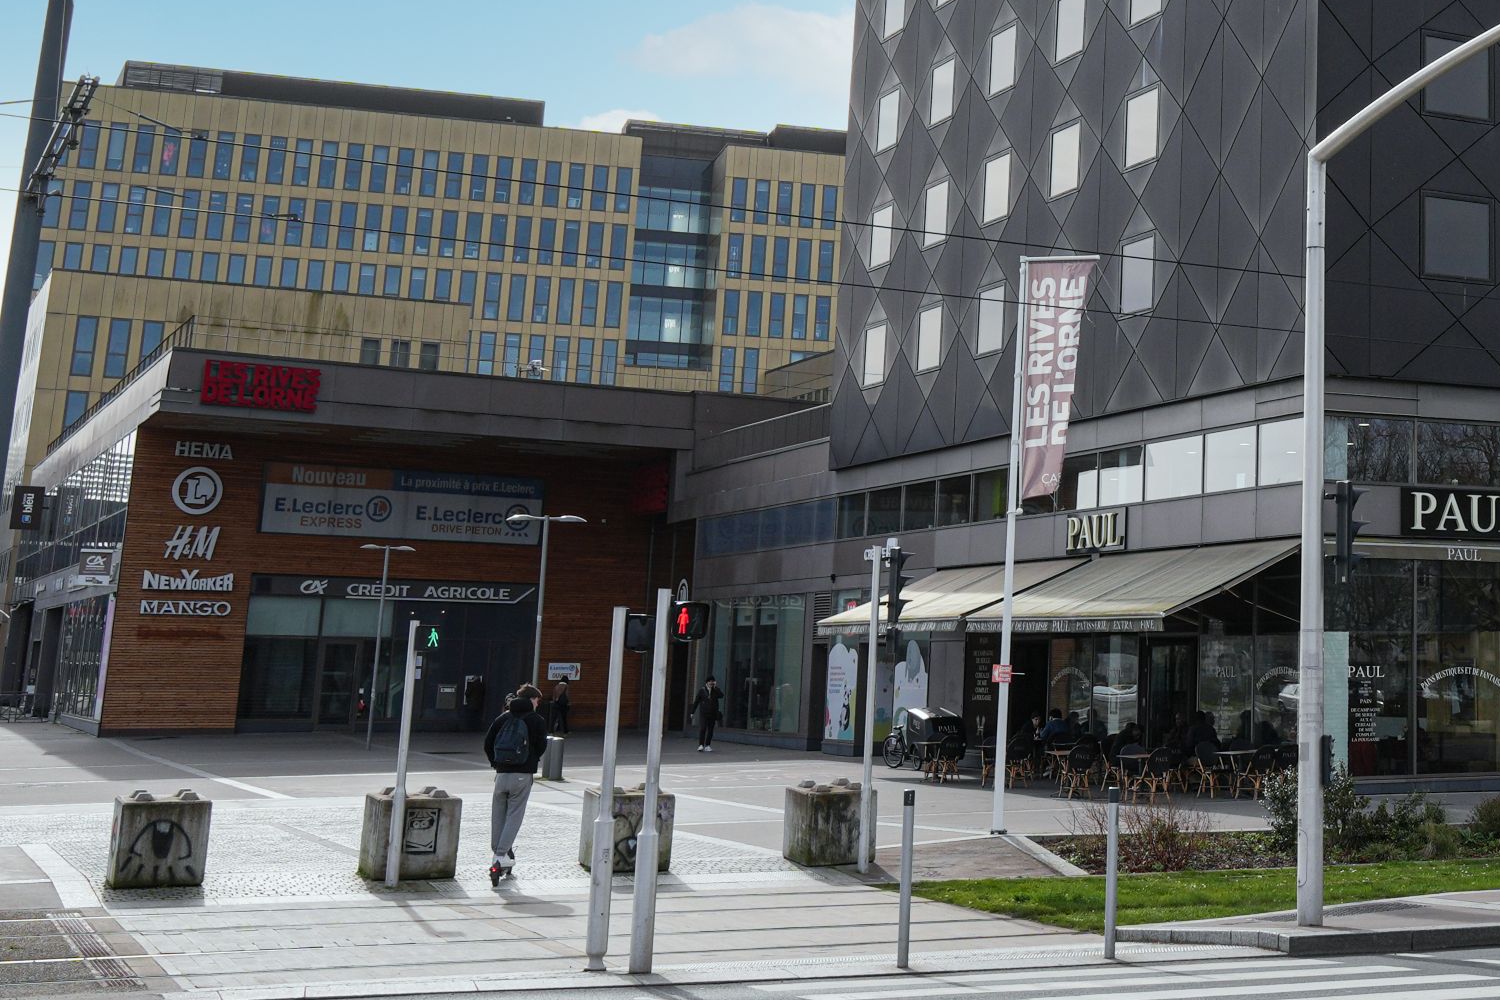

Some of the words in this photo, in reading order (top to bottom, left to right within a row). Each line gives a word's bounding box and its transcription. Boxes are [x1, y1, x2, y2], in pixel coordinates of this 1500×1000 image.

[1028, 277, 1057, 376] RIVES
[204, 359, 249, 386] LES
[252, 364, 322, 391] RIVES
[201, 383, 232, 405] DE
[1025, 384, 1051, 448] LES
[175, 440, 233, 460] HEMA
[292, 466, 367, 487] Nouveau
[401, 476, 413, 487] La
[415, 477, 461, 491] proximité
[463, 479, 470, 490] à
[472, 481, 490, 492] prix
[492, 481, 536, 495] E.Leclerc
[274, 496, 364, 517] E.Leclerc
[415, 505, 502, 525] E.Leclerc
[300, 516, 362, 529] EXPRESS
[431, 523, 463, 534] DRIVE
[1066, 512, 1120, 550] PAUL
[163, 525, 221, 561] H&M
[1447, 548, 1482, 561] PAUL
[300, 579, 328, 595] CA
[346, 580, 411, 597] CRÉDIT
[424, 584, 511, 600] AGRICOLE
[140, 600, 232, 616] MANGO
[1052, 621, 1069, 632] PAUL
[1113, 621, 1133, 630] EXTRA
[1140, 620, 1155, 629] FINE
[1216, 666, 1236, 678] PAUL
[1347, 665, 1386, 678] PAUL
[1420, 675, 1436, 690] PAINS
[1435, 667, 1465, 681] RUSTIQUES
[1465, 667, 1472, 675] ET
[1472, 667, 1480, 676] DE
[938, 725, 957, 733] PAUL
